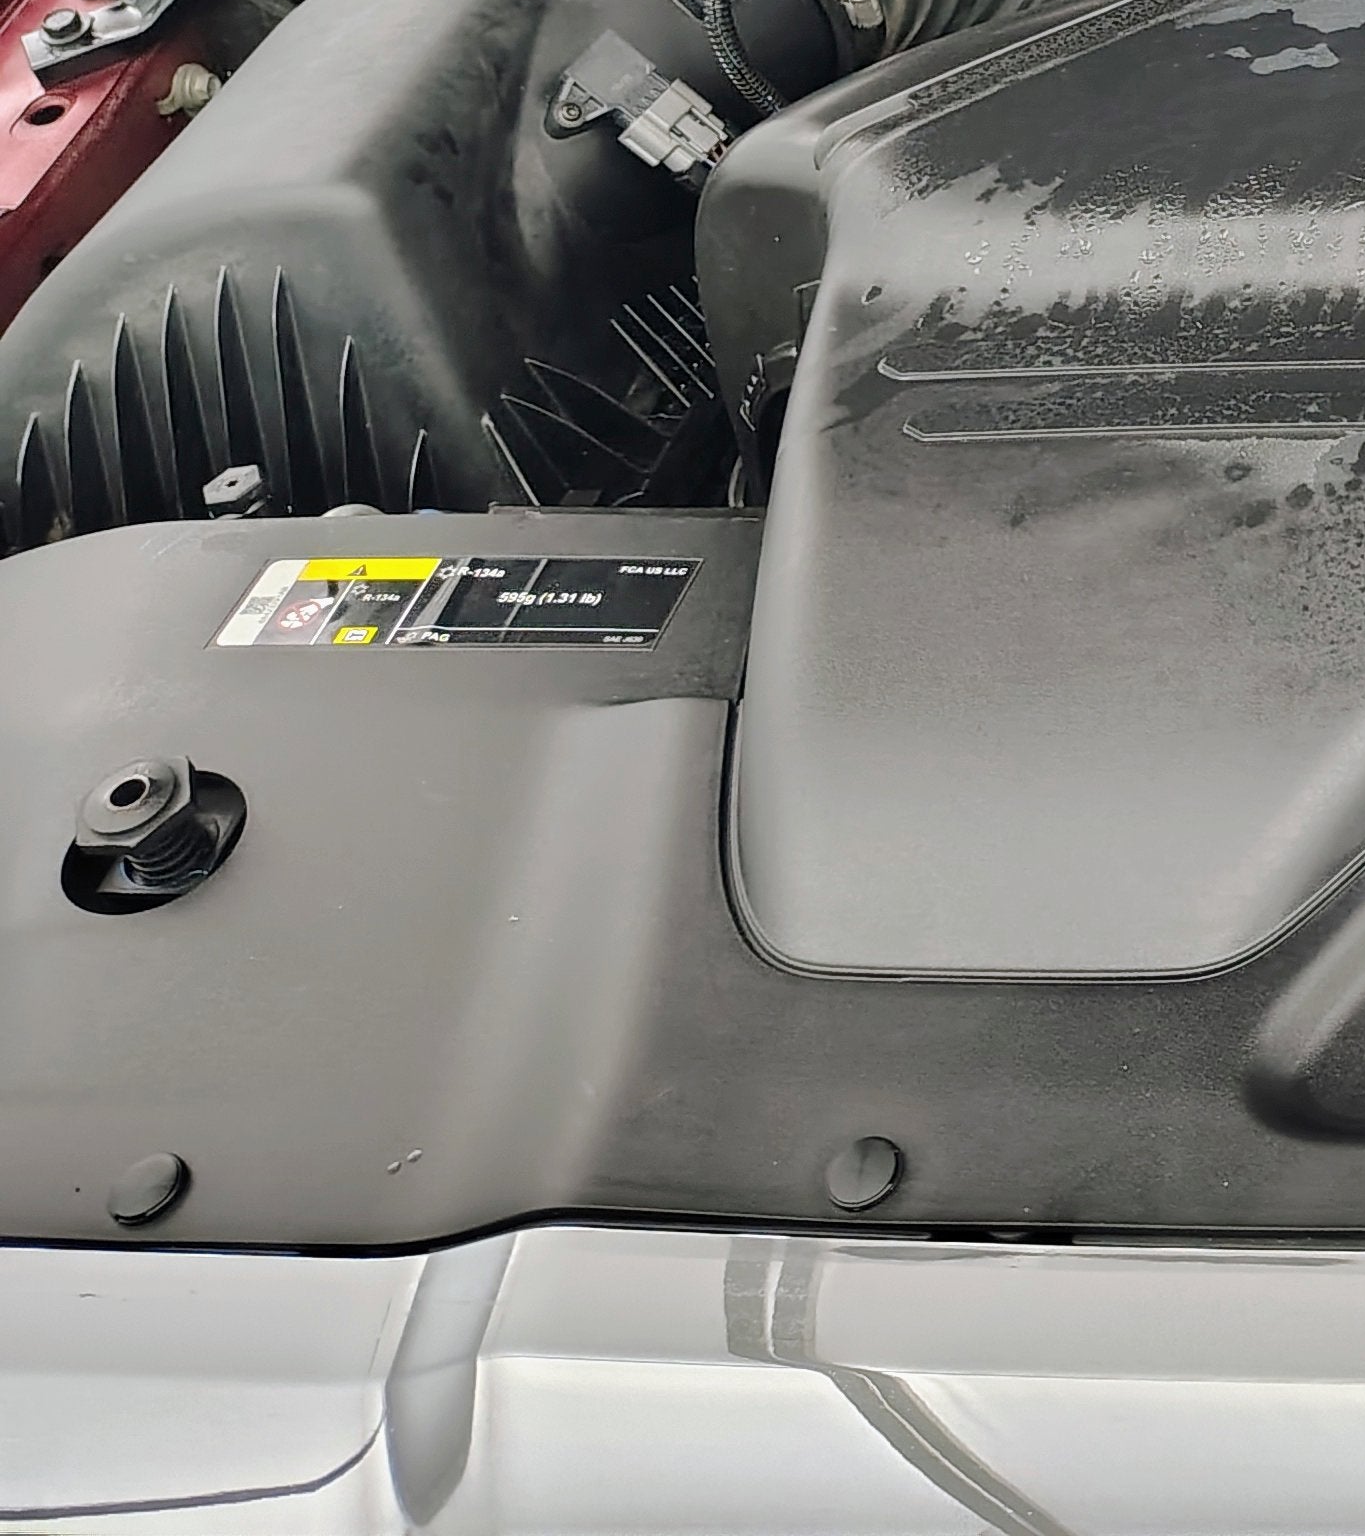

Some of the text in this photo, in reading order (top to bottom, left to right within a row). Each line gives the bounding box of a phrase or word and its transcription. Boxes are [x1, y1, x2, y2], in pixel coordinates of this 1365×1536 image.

[618, 566, 688, 576] FCA US LLC
[362, 593, 401, 602] R-134a
[497, 591, 602, 607] 595g (1.31 lb)
[420, 632, 450, 643] PAG
